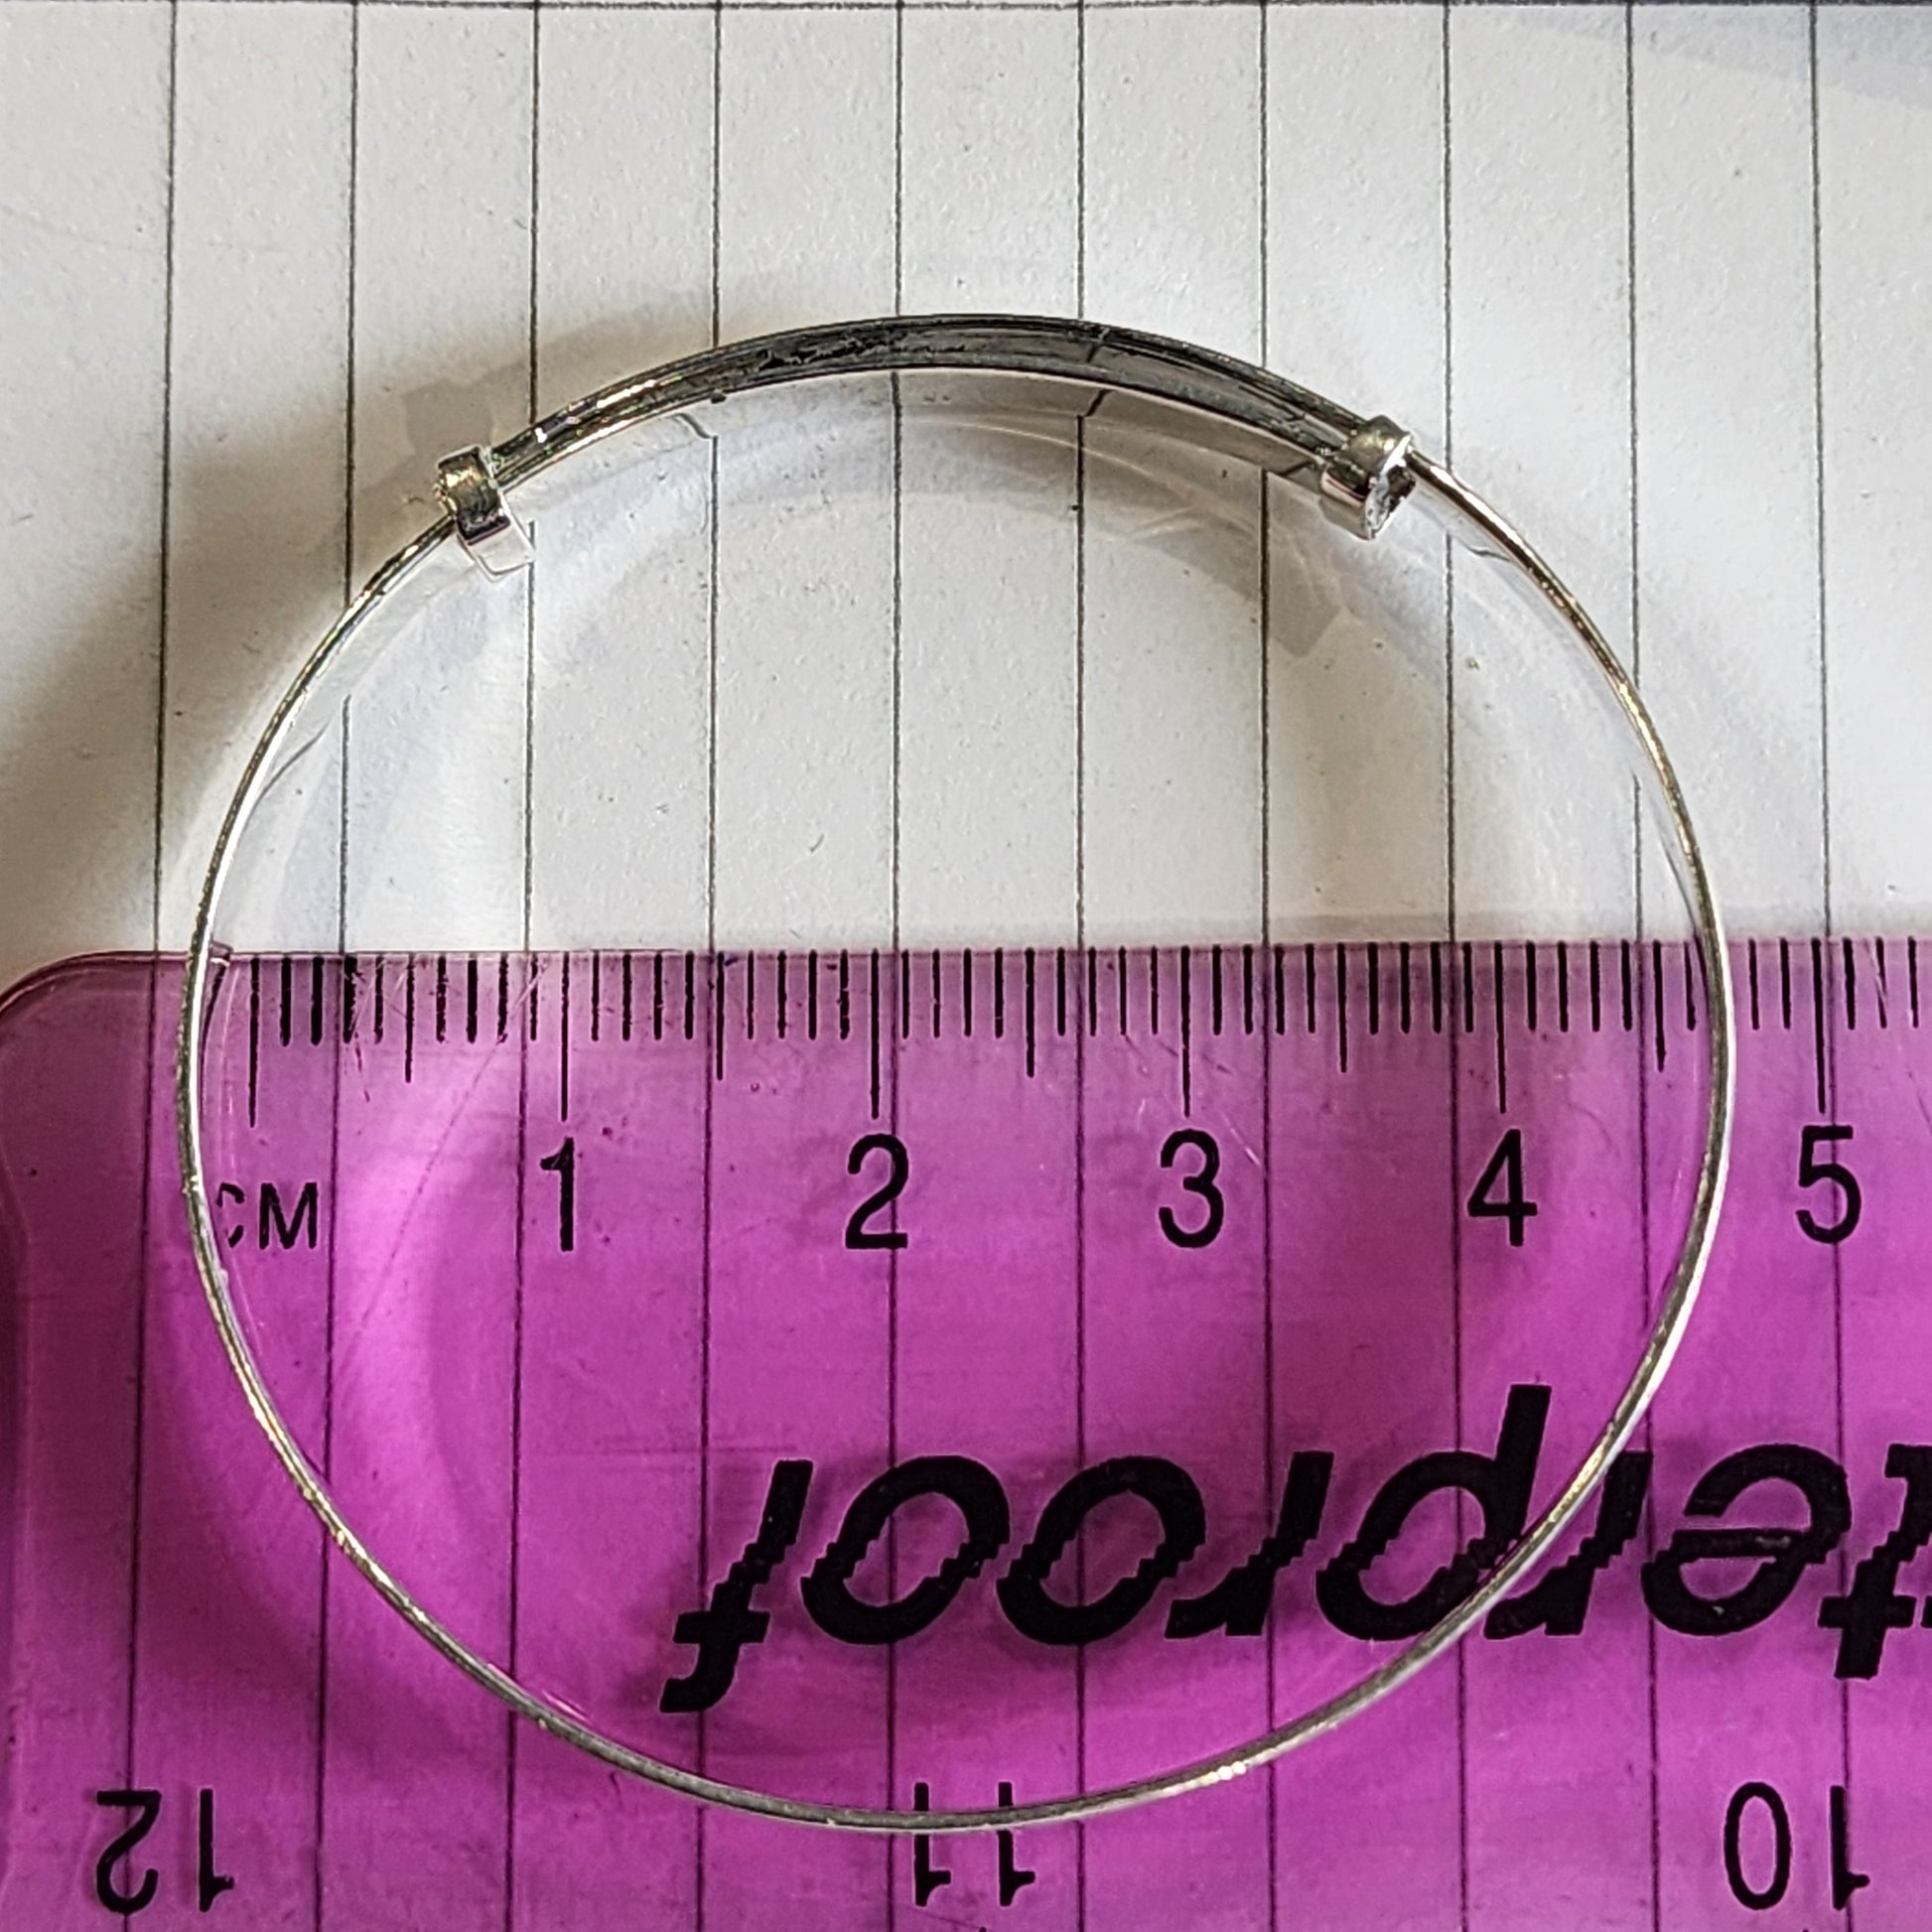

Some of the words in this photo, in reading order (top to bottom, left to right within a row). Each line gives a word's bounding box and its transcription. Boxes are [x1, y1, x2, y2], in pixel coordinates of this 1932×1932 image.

[216, 1181, 319, 1251] CM
[539, 1137, 576, 1252] 1
[845, 1133, 909, 1250] 2
[1158, 1128, 1225, 1249] 3
[1466, 1128, 1538, 1247] 4
[1795, 1125, 1863, 1244] 5
[659, 1383, 1932, 1714] terproof
[95, 1788, 235, 1915] 12
[912, 1781, 1036, 1908] 11
[1723, 1781, 1871, 1911] 10
